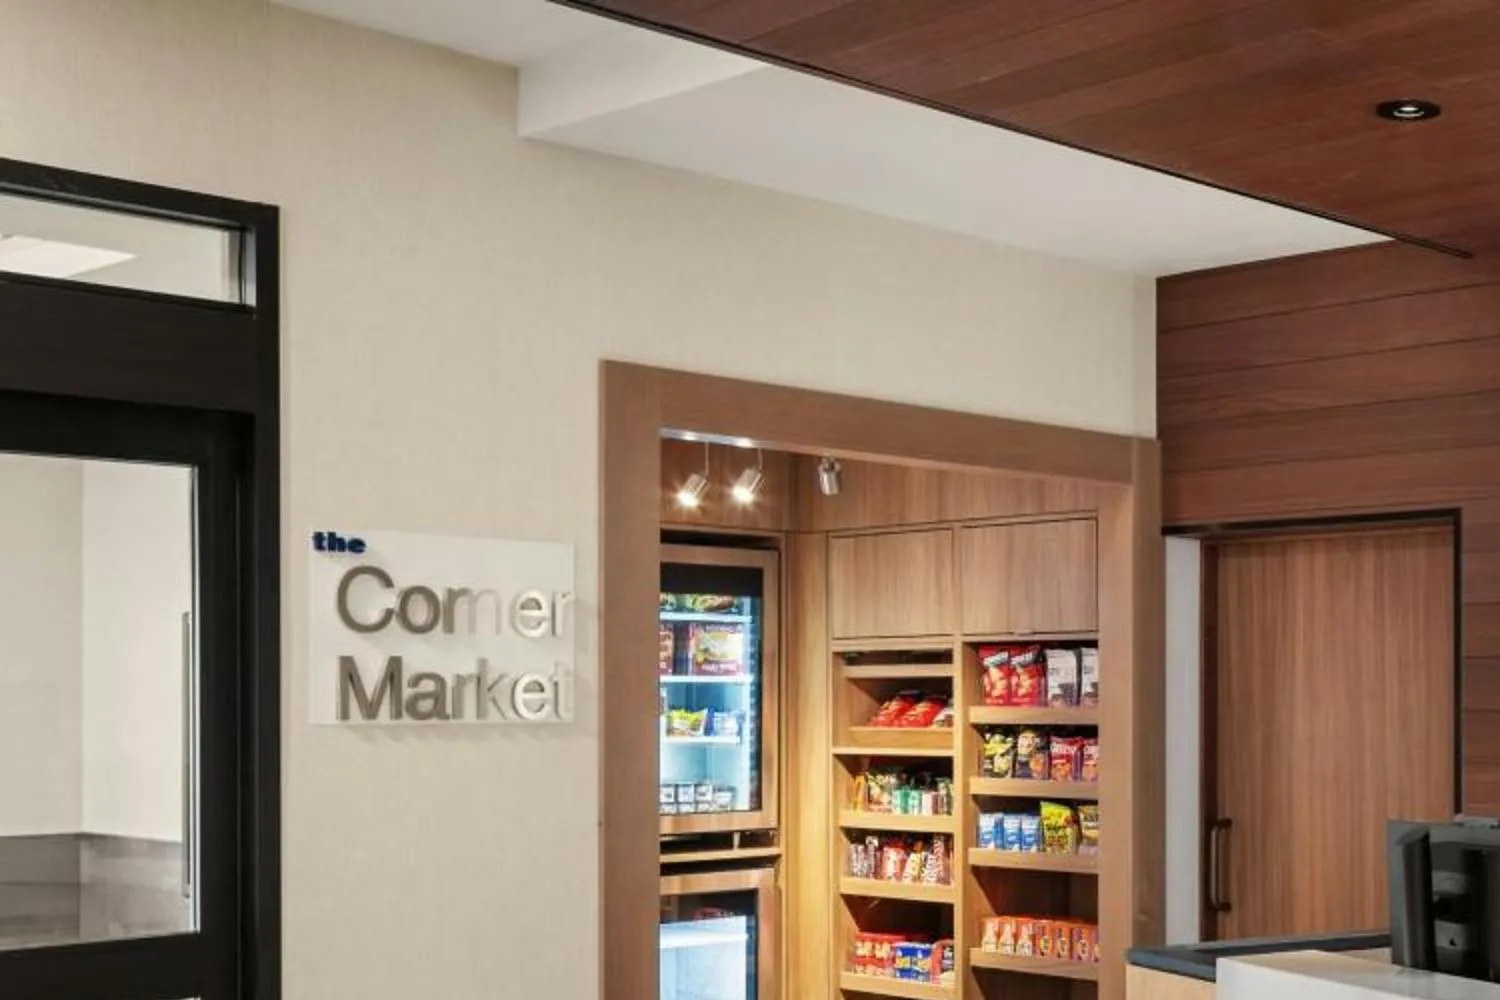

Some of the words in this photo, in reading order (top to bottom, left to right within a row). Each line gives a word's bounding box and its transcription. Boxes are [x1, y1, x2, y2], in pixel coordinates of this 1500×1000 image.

[312, 531, 367, 554] the
[337, 565, 575, 638] Corner
[337, 655, 573, 721] Market
